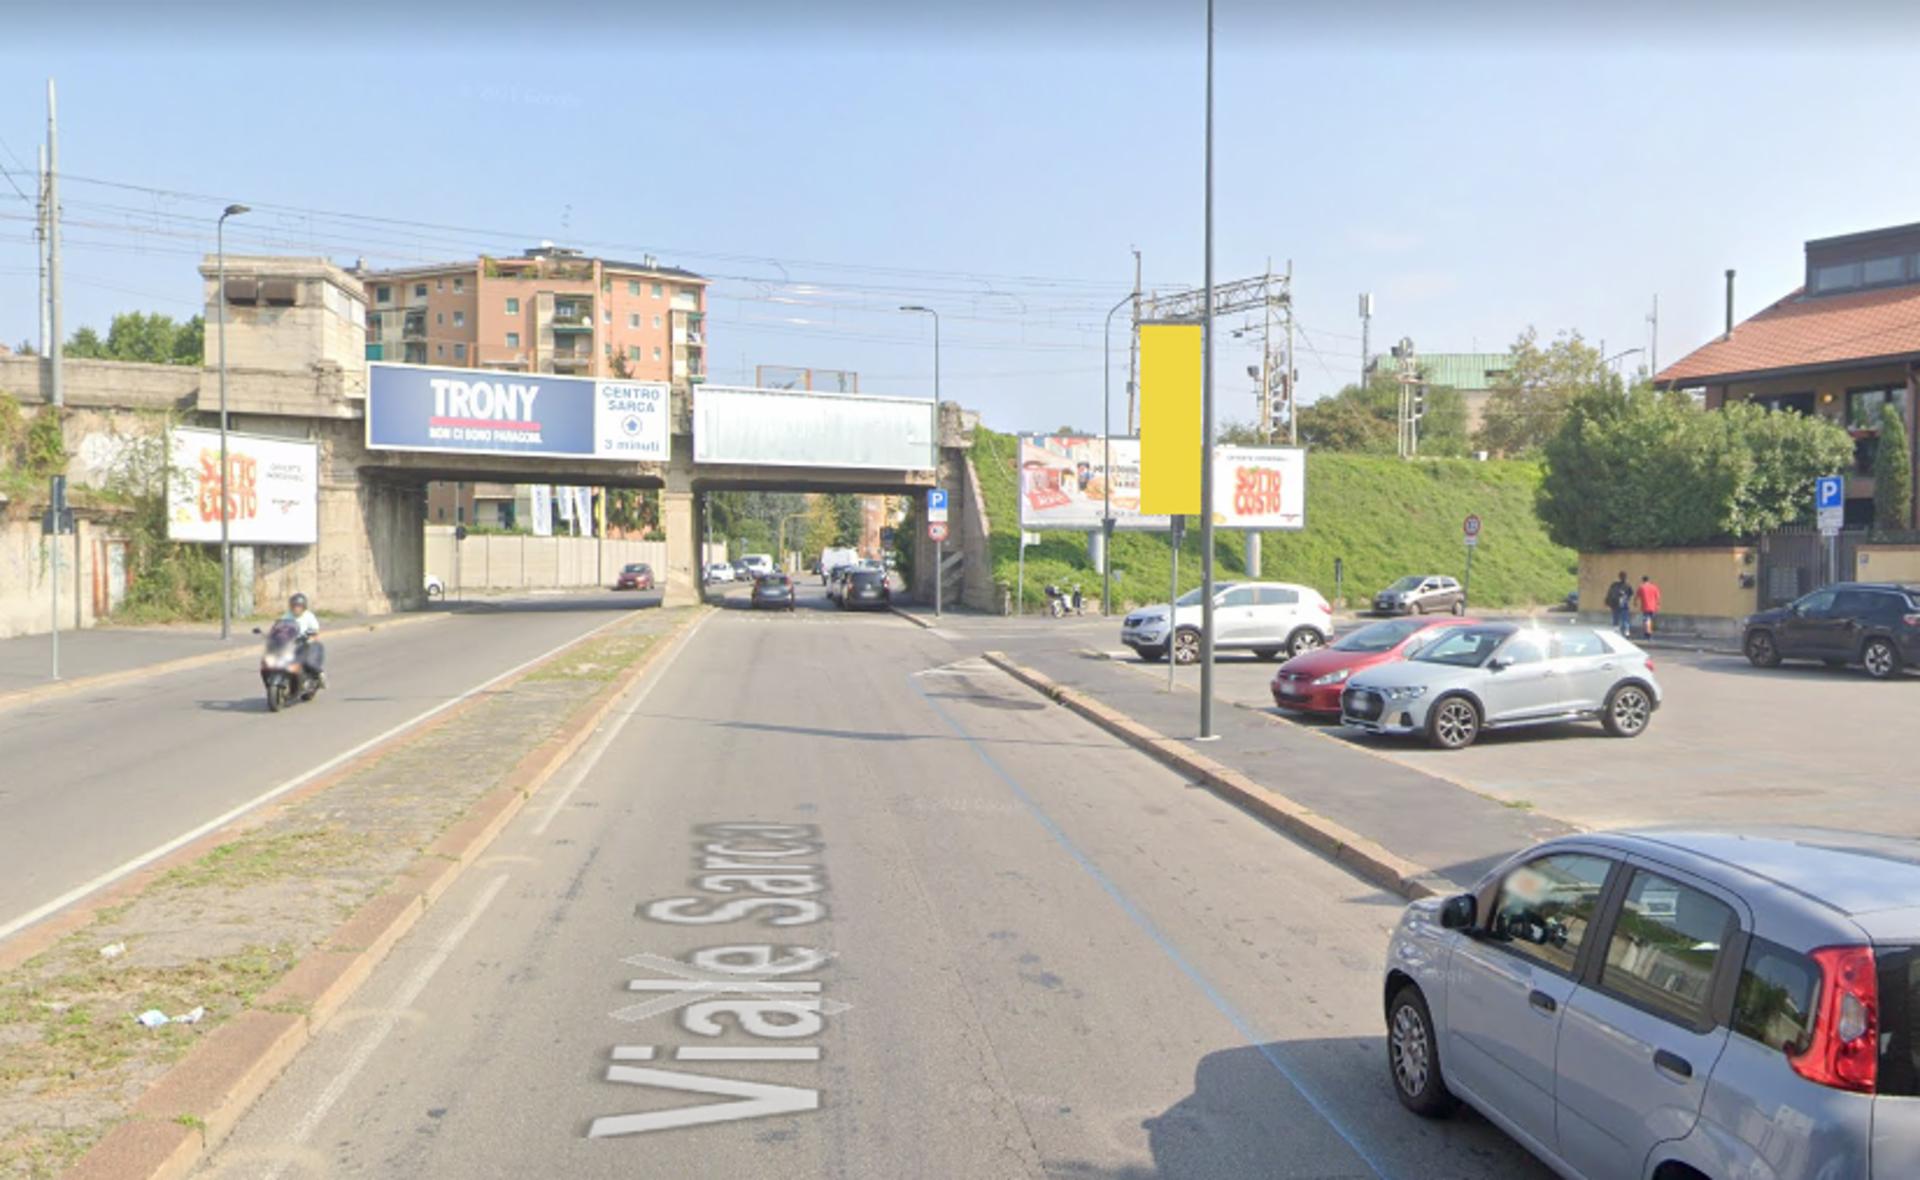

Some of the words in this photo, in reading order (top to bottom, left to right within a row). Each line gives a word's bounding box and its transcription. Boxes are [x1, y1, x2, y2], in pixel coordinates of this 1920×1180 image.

[430, 378, 540, 422] TRONY
[602, 385, 661, 401] CENTRO
[608, 399, 656, 413] SARCA
[604, 438, 613, 450] 3
[616, 440, 660, 452] minuti
[199, 448, 257, 486] SOTTO
[1235, 465, 1282, 493] SOTTO
[199, 484, 257, 523] COSTO
[932, 492, 944, 507] P
[1233, 490, 1281, 516] COSTO
[1822, 481, 1838, 505] P
